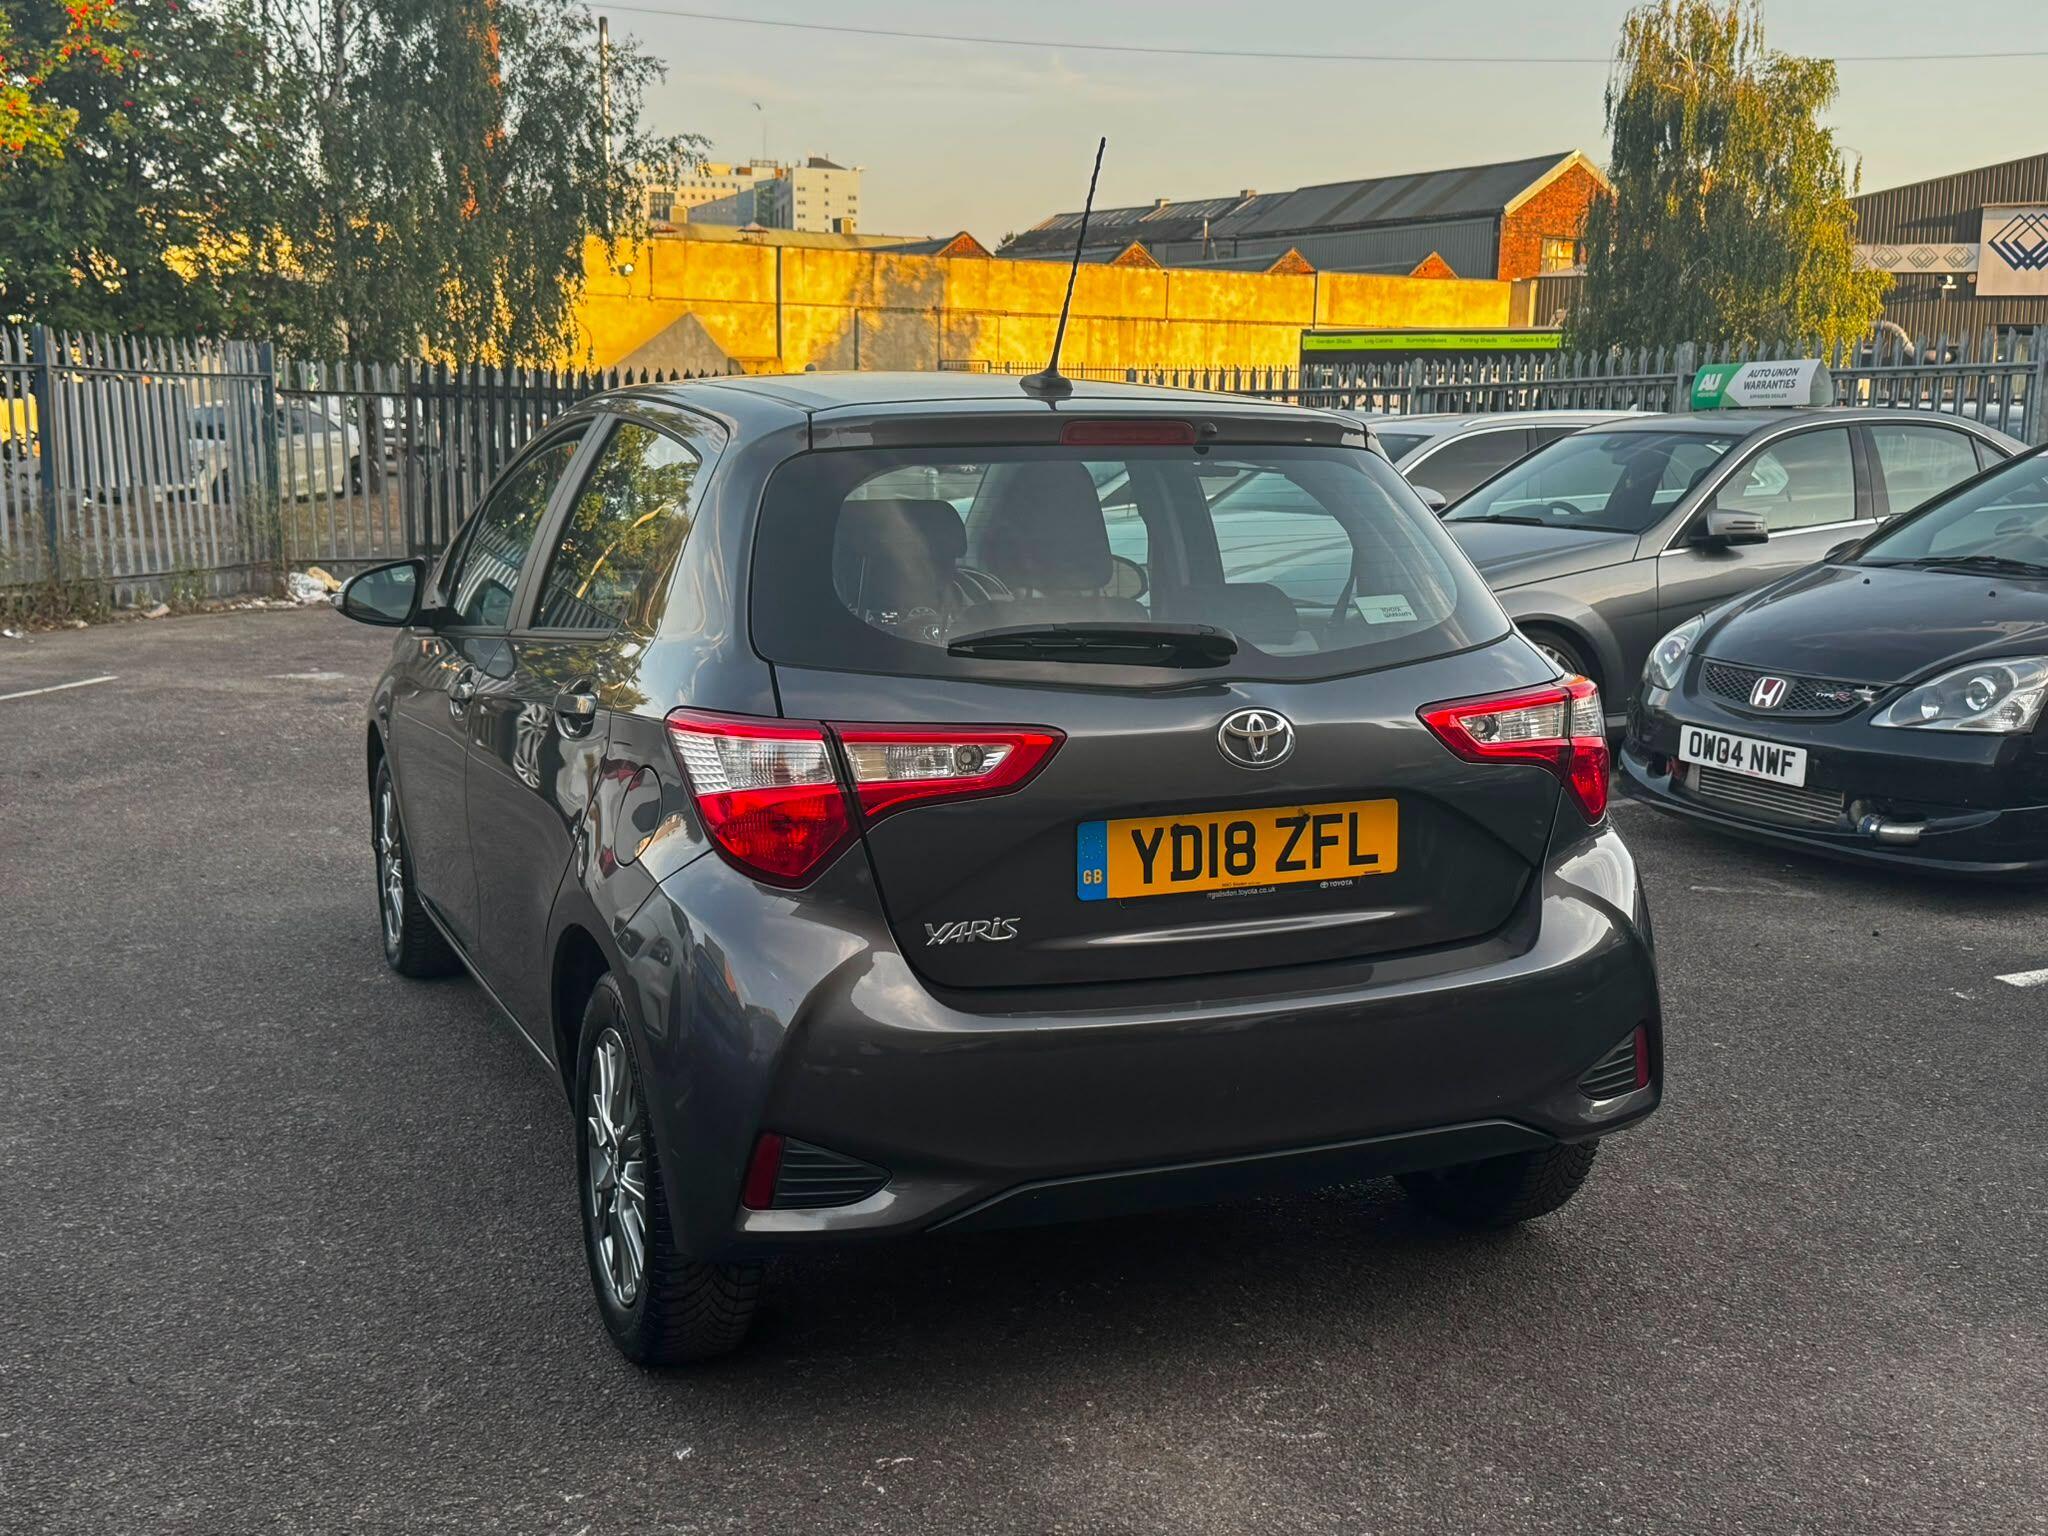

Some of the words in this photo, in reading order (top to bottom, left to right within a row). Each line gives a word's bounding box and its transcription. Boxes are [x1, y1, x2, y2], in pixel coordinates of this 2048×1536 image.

[1748, 368, 1771, 378] AUTO
[1771, 367, 1800, 377] UNION
[1698, 373, 1722, 391] AU
[1743, 379, 1796, 390] WARRANTIES
[1833, 691, 1850, 701] R
[1690, 731, 1743, 767] OW04
[1749, 744, 1796, 777] NWF
[1130, 820, 1256, 884] YD18
[1275, 812, 1379, 873] ZFL
[1083, 869, 1103, 885] GB
[1329, 879, 1354, 888] TOYOTA
